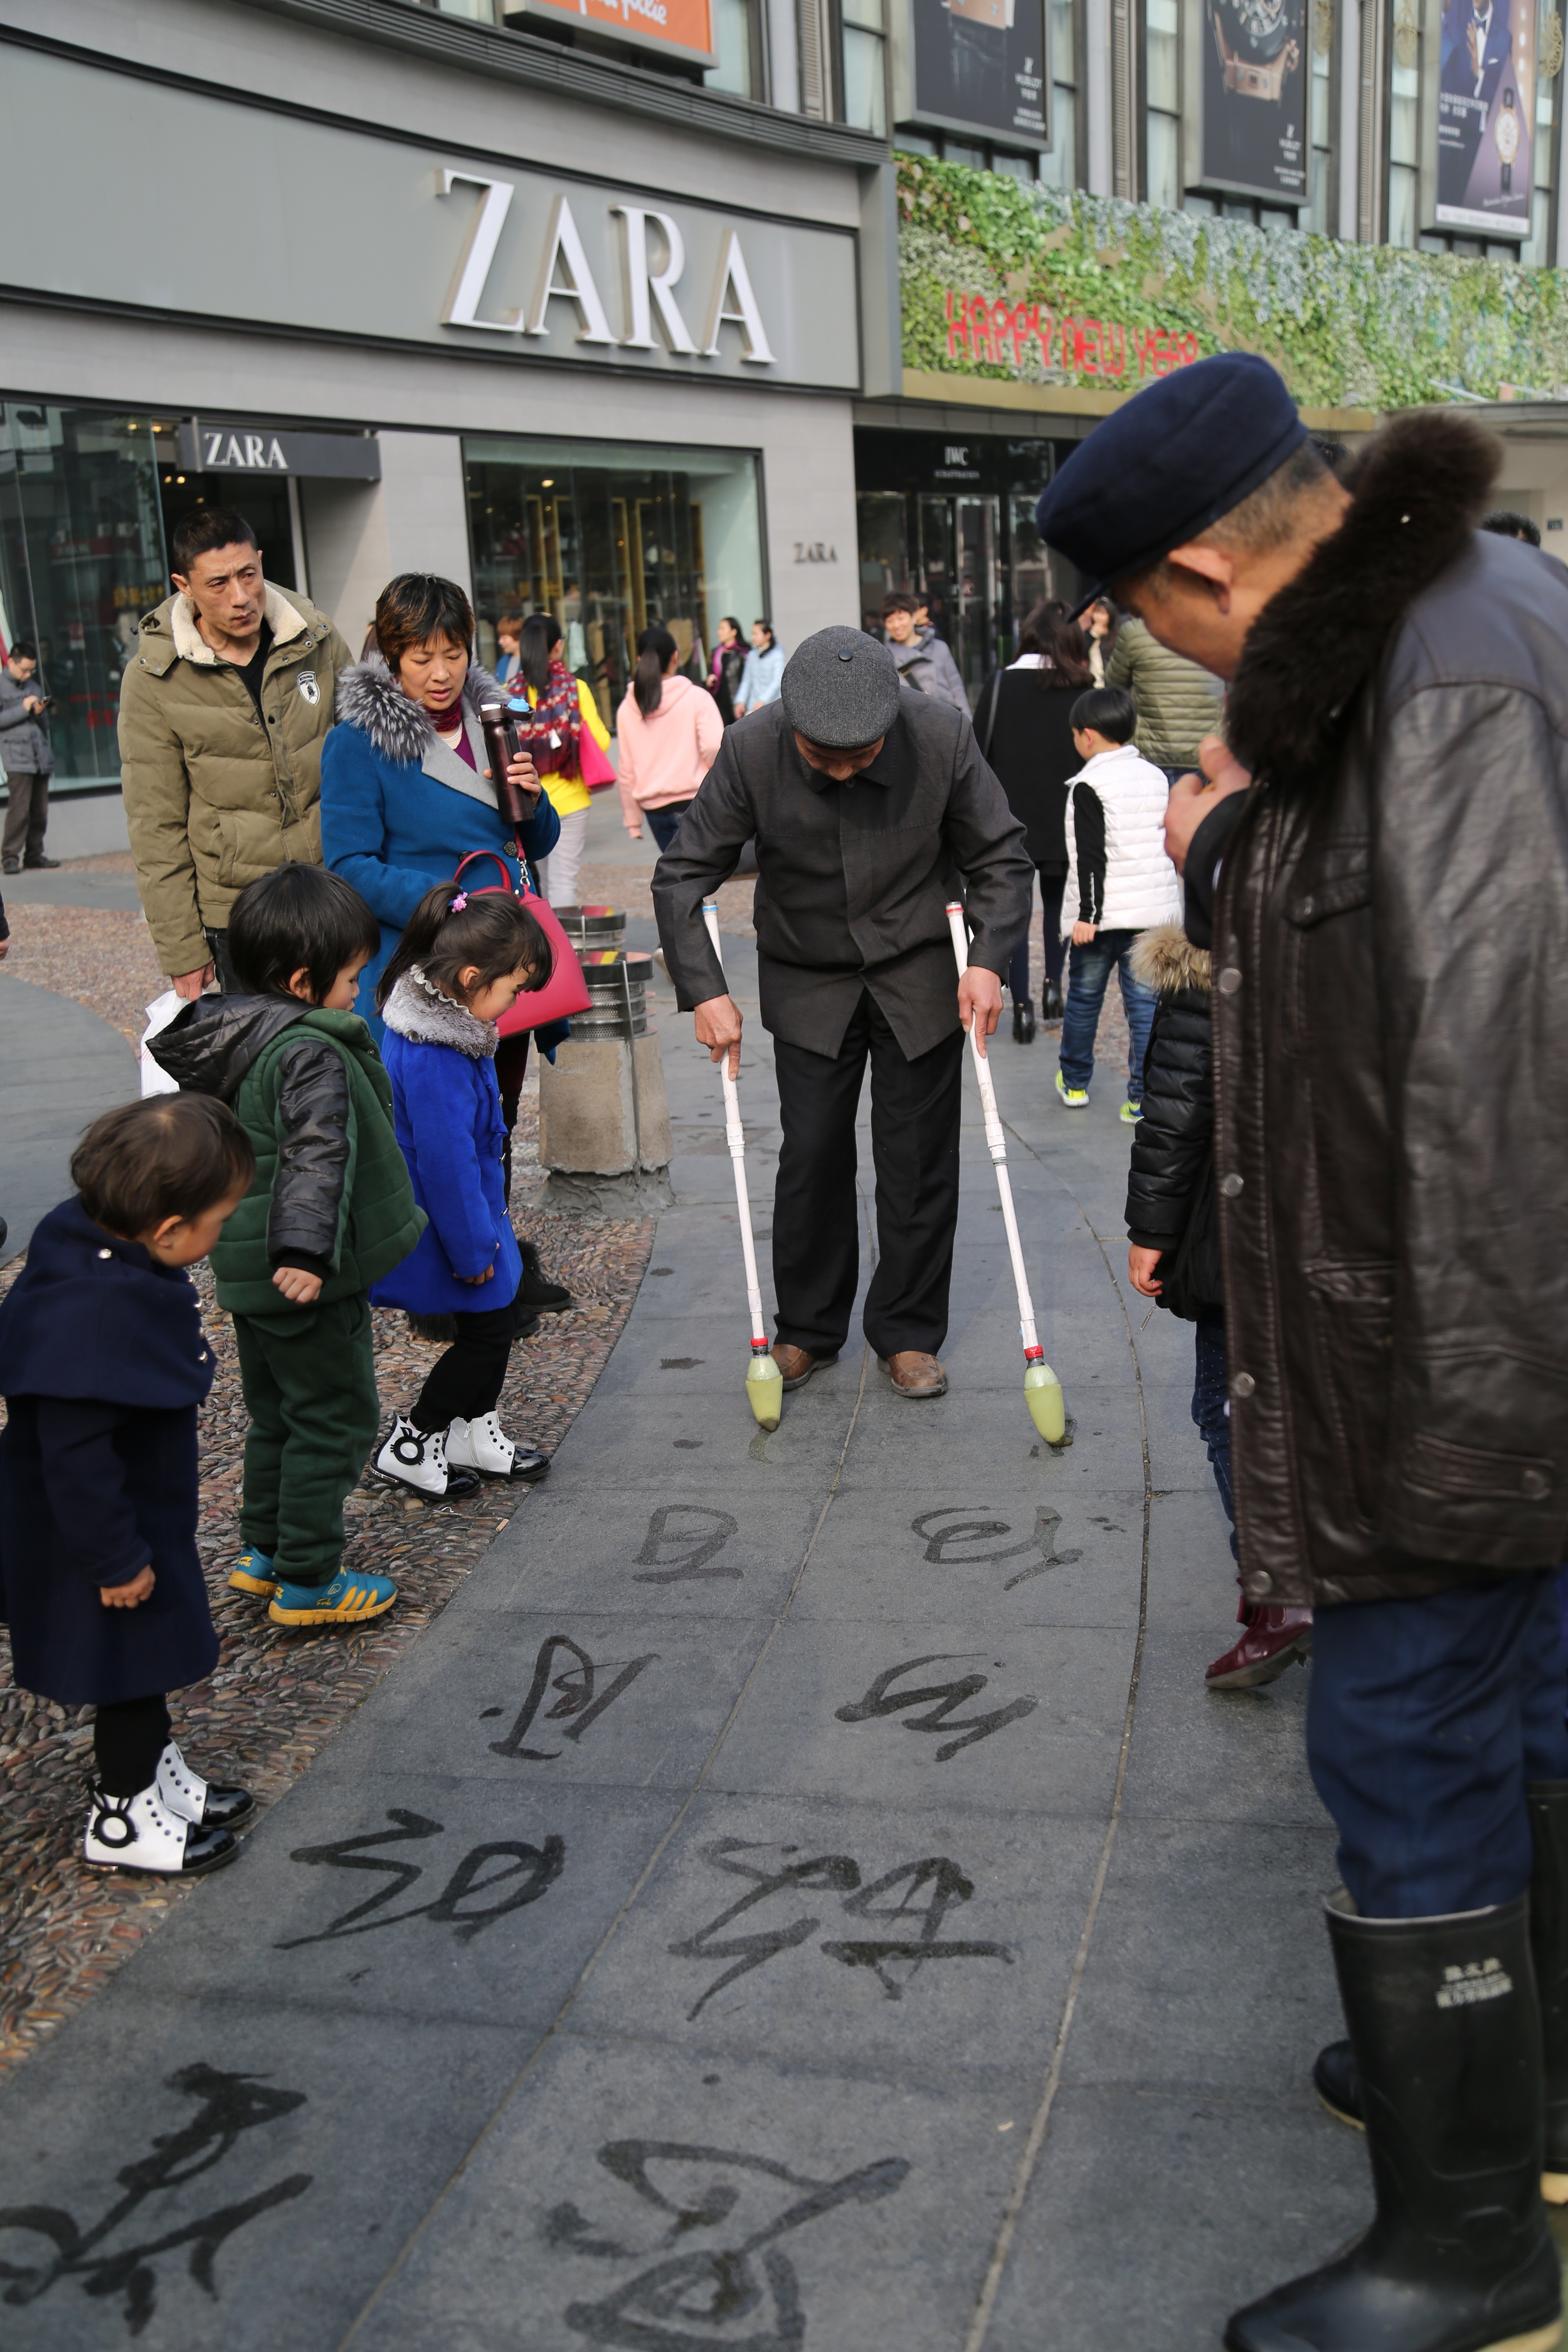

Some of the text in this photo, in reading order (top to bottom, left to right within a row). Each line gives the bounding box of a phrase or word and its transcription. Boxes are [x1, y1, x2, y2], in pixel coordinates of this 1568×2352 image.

[434, 168, 777, 364] ZARA
[946, 290, 1199, 378] HAPPY NEW YEAR
[204, 432, 289, 469] ZARA
[945, 446, 969, 466] IWC
[793, 541, 839, 563] ZARA
